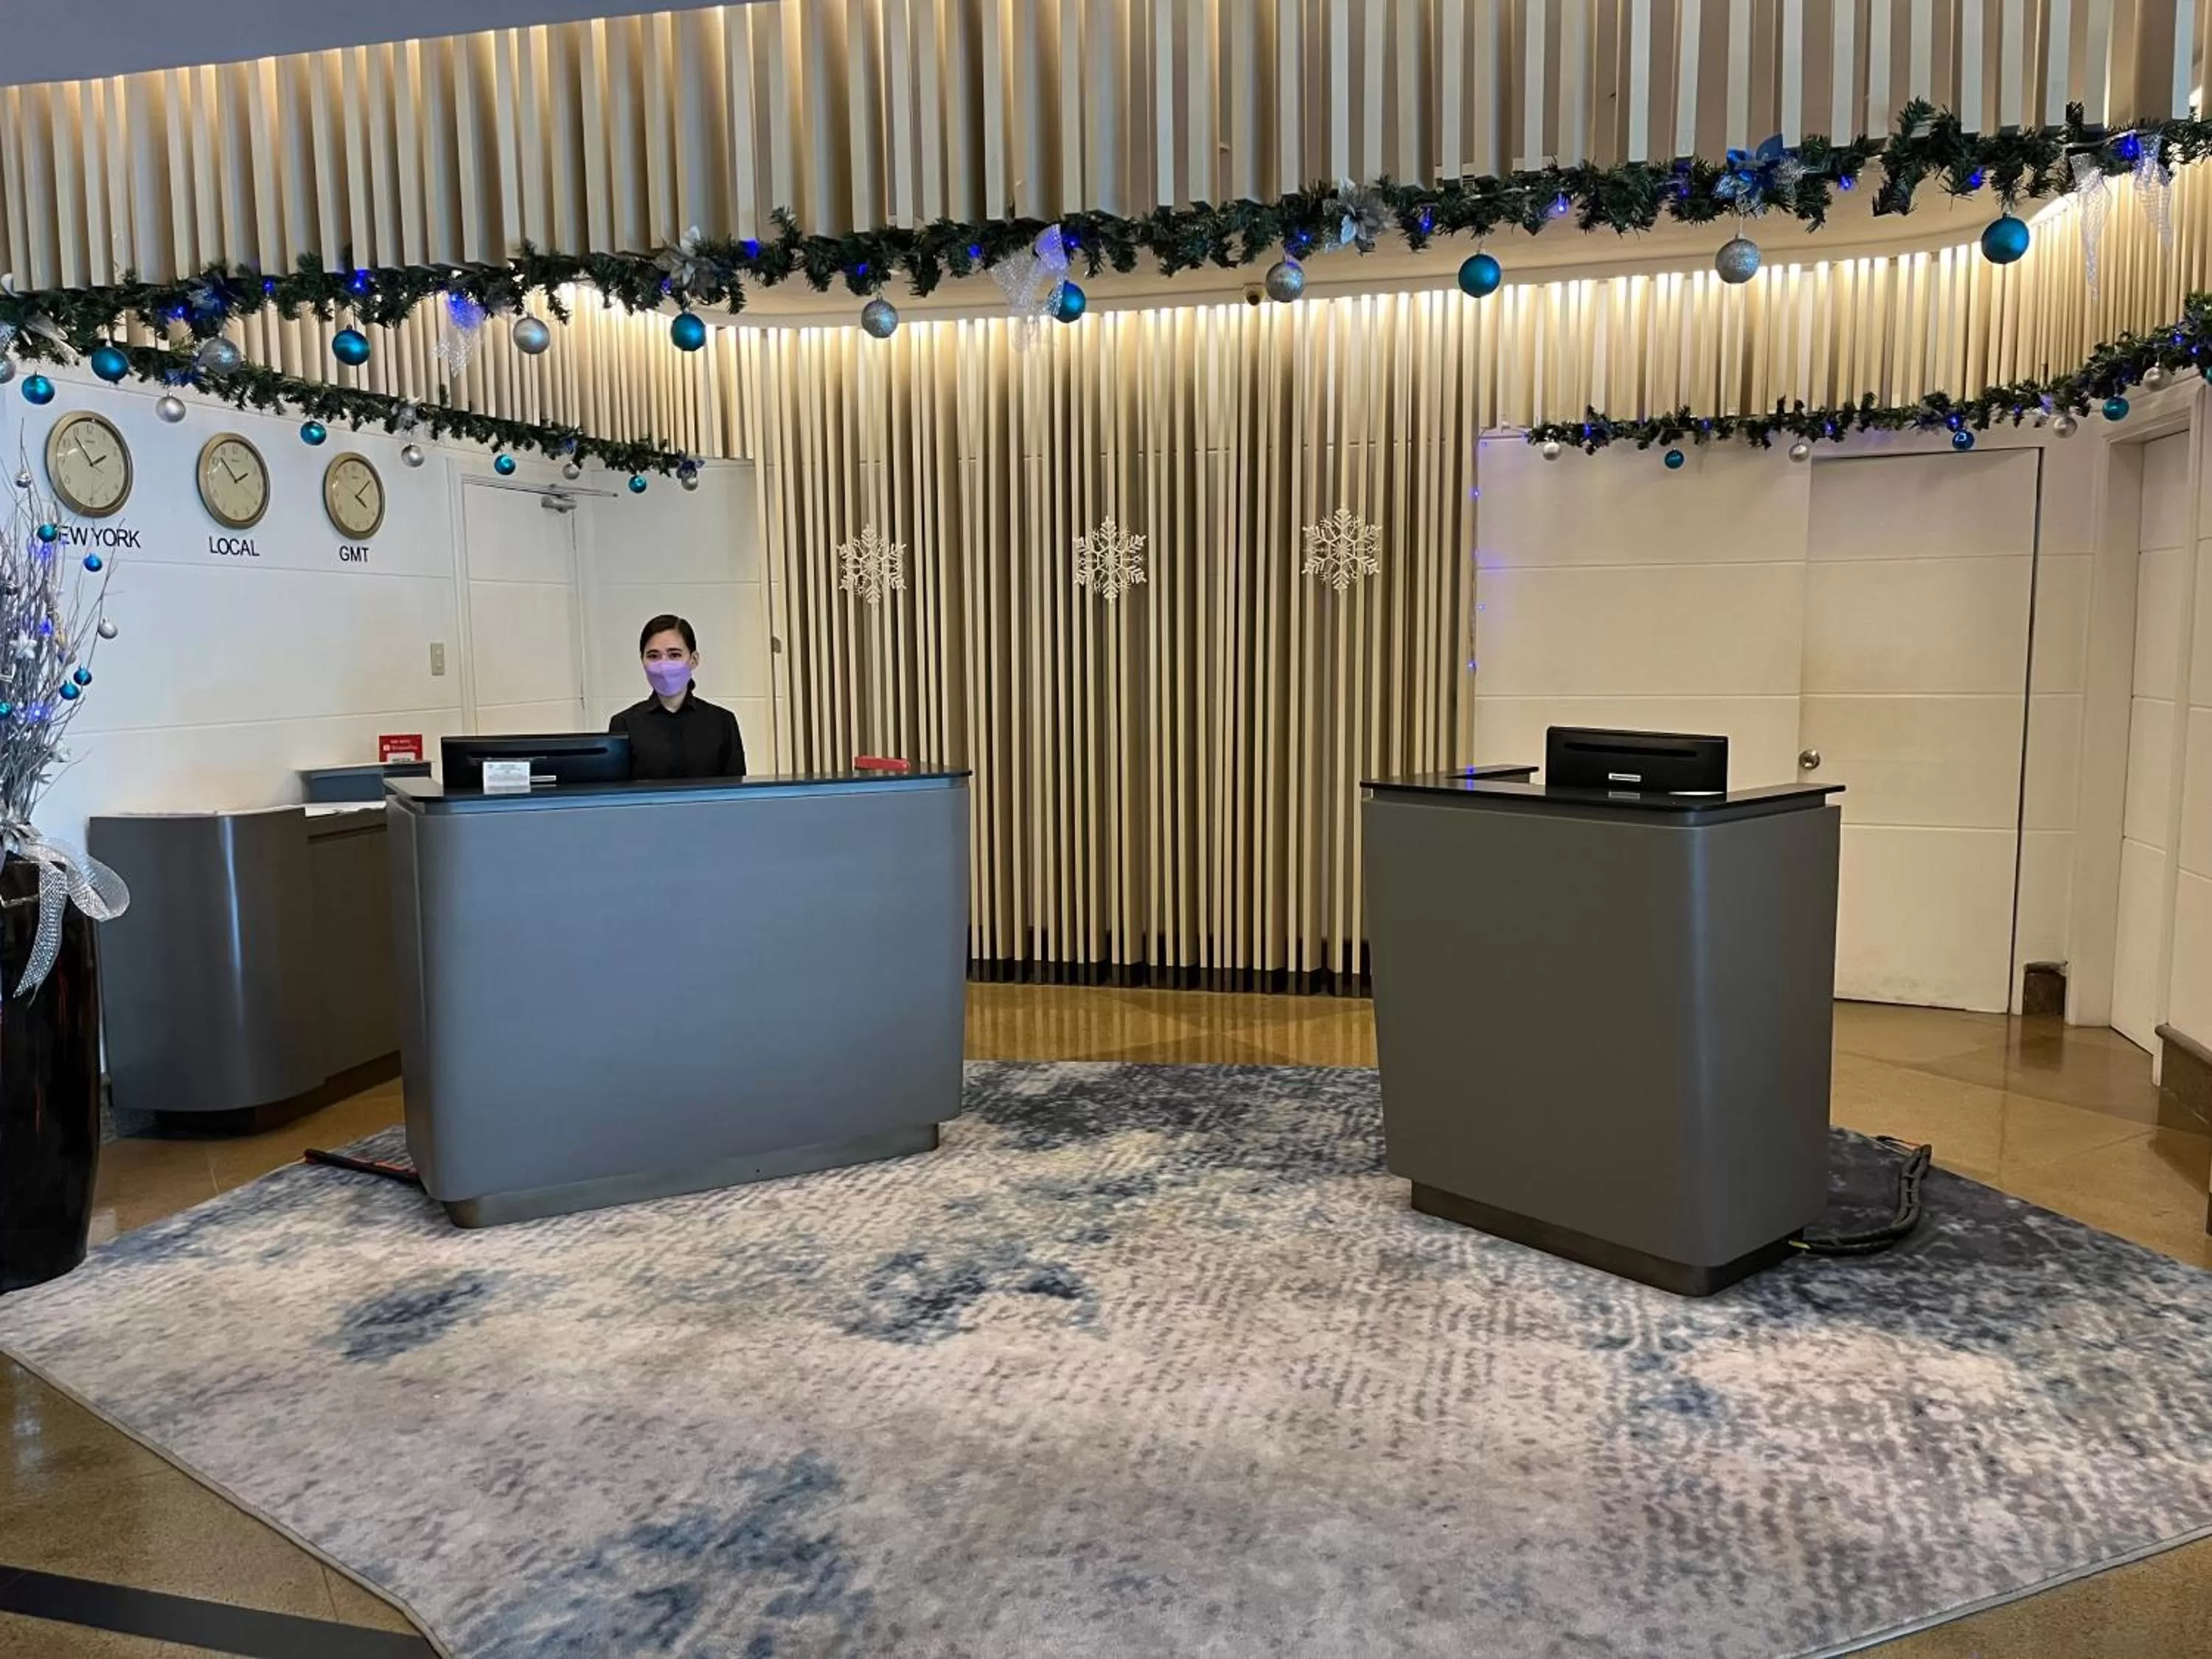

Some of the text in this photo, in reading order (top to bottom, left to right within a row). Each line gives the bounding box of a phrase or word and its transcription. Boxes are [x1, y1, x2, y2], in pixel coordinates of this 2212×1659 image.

[57, 526, 141, 548] EW YORK
[209, 536, 260, 557] LOCAL
[339, 545, 369, 562] GMT
